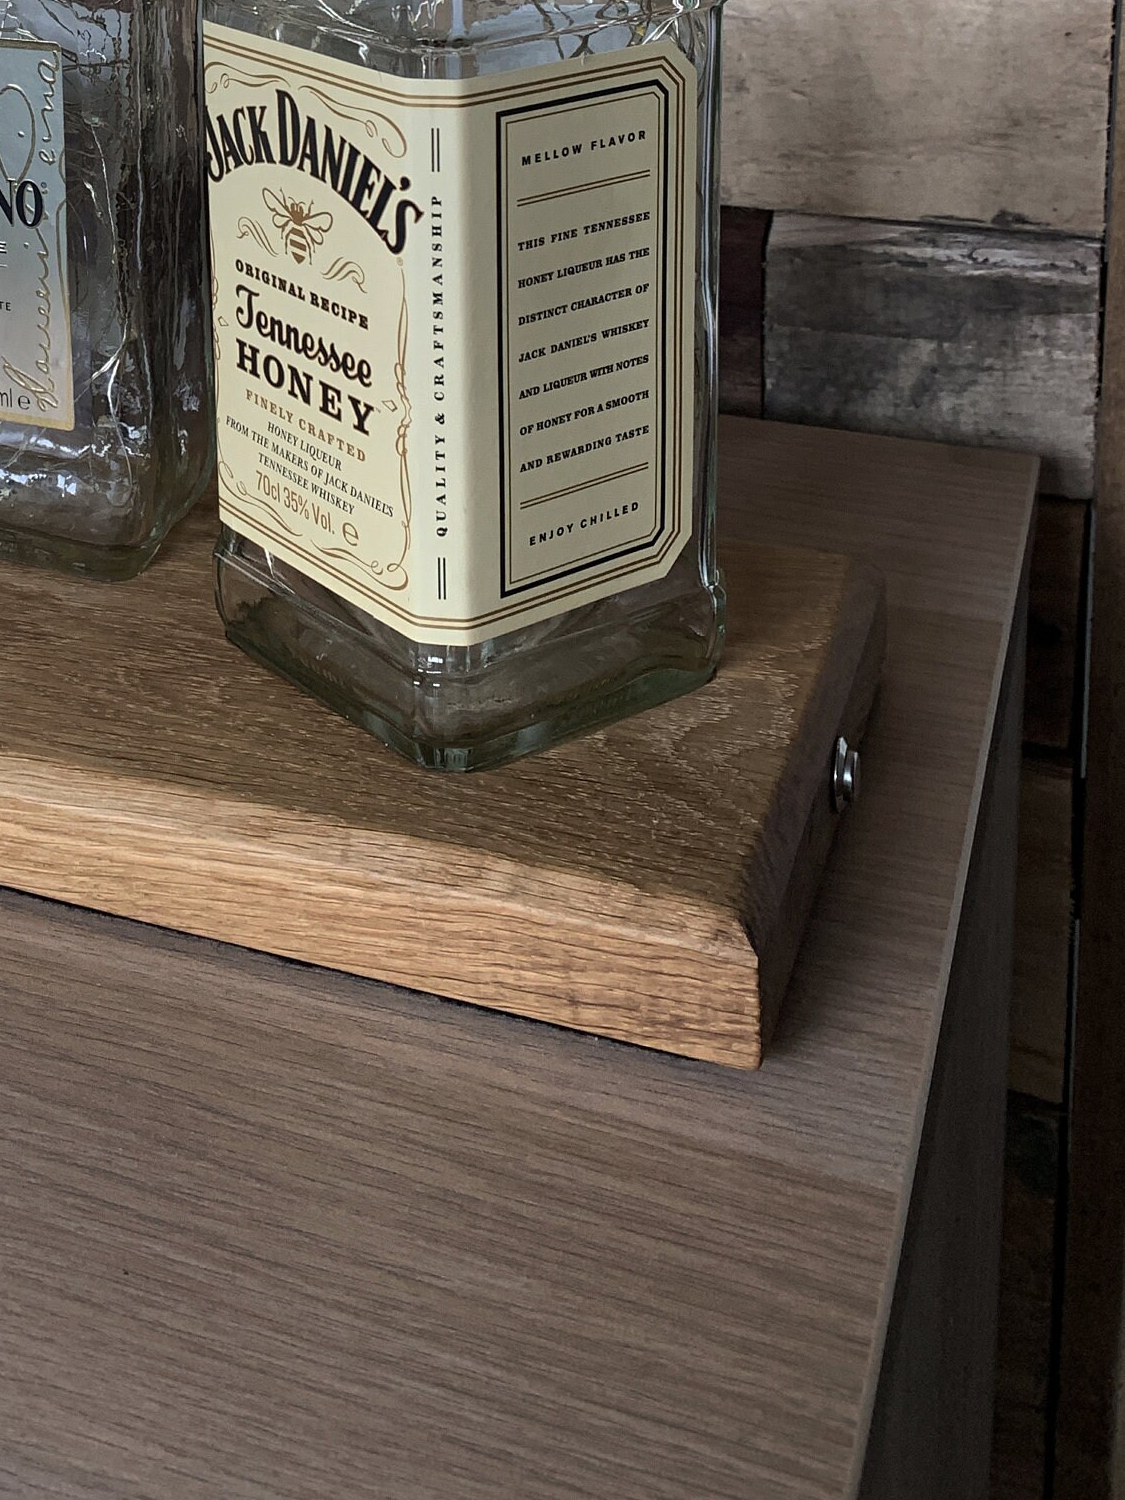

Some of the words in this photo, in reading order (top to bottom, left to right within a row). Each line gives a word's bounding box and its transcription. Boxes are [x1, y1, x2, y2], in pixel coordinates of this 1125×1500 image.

[205, 104, 277, 183] JACK
[275, 88, 424, 255] DANIEL'S
[521, 143, 583, 166] MELLOW
[590, 130, 646, 151] FLAVOR
[517, 237, 545, 251] THIS
[551, 229, 578, 244] FINE
[583, 211, 650, 235] TENNESSEE
[518, 272, 554, 288] HONEY
[557, 259, 603, 279] LIQUEUR
[605, 253, 626, 266] HAS
[629, 247, 650, 260] THE
[235, 259, 306, 301] ORIGINAL
[309, 290, 369, 330] RECIPE
[431, 195, 445, 401] CRAFTSMANSHIP
[518, 305, 568, 326] DISTINCT
[570, 287, 632, 312] CHARACTER
[635, 283, 650, 295] OF
[235, 283, 372, 388] Tennessee
[518, 347, 547, 363] JACK
[550, 333, 597, 354] DANIEL'S
[601, 319, 650, 339] WHISKEY
[235, 337, 375, 436] HONEY
[518, 386, 540, 400] AND
[543, 372, 588, 393] LIQUEUR
[589, 364, 614, 379] WITH
[615, 355, 649, 371] NOTES
[245, 389, 294, 424] FINELY
[298, 416, 366, 463] CRAFTED
[435, 413, 446, 426] &
[520, 424, 534, 436] OF
[536, 413, 572, 431] HONEY
[574, 406, 595, 420] FOR
[596, 403, 604, 413] A
[605, 390, 650, 410] SMOOTH
[226, 415, 250, 438] FROM
[251, 429, 270, 449] THE
[271, 441, 309, 473] MAKERS
[311, 463, 324, 479] OF
[325, 471, 349, 494] JACK
[267, 421, 298, 446] HONEY
[300, 437, 343, 472] LIQUEUR
[520, 459, 543, 473] AND
[546, 437, 612, 465] REWARDING
[615, 425, 650, 443] TASTE
[256, 470, 281, 503] 70cl
[283, 487, 310, 520] 35%
[312, 499, 336, 535] Vol.
[259, 452, 309, 490] TENNESSEE
[311, 483, 355, 515] WHISKEY
[436, 434, 448, 537] QUALITY
[529, 523, 574, 546] ENJOY
[580, 502, 639, 529] CHILLED
